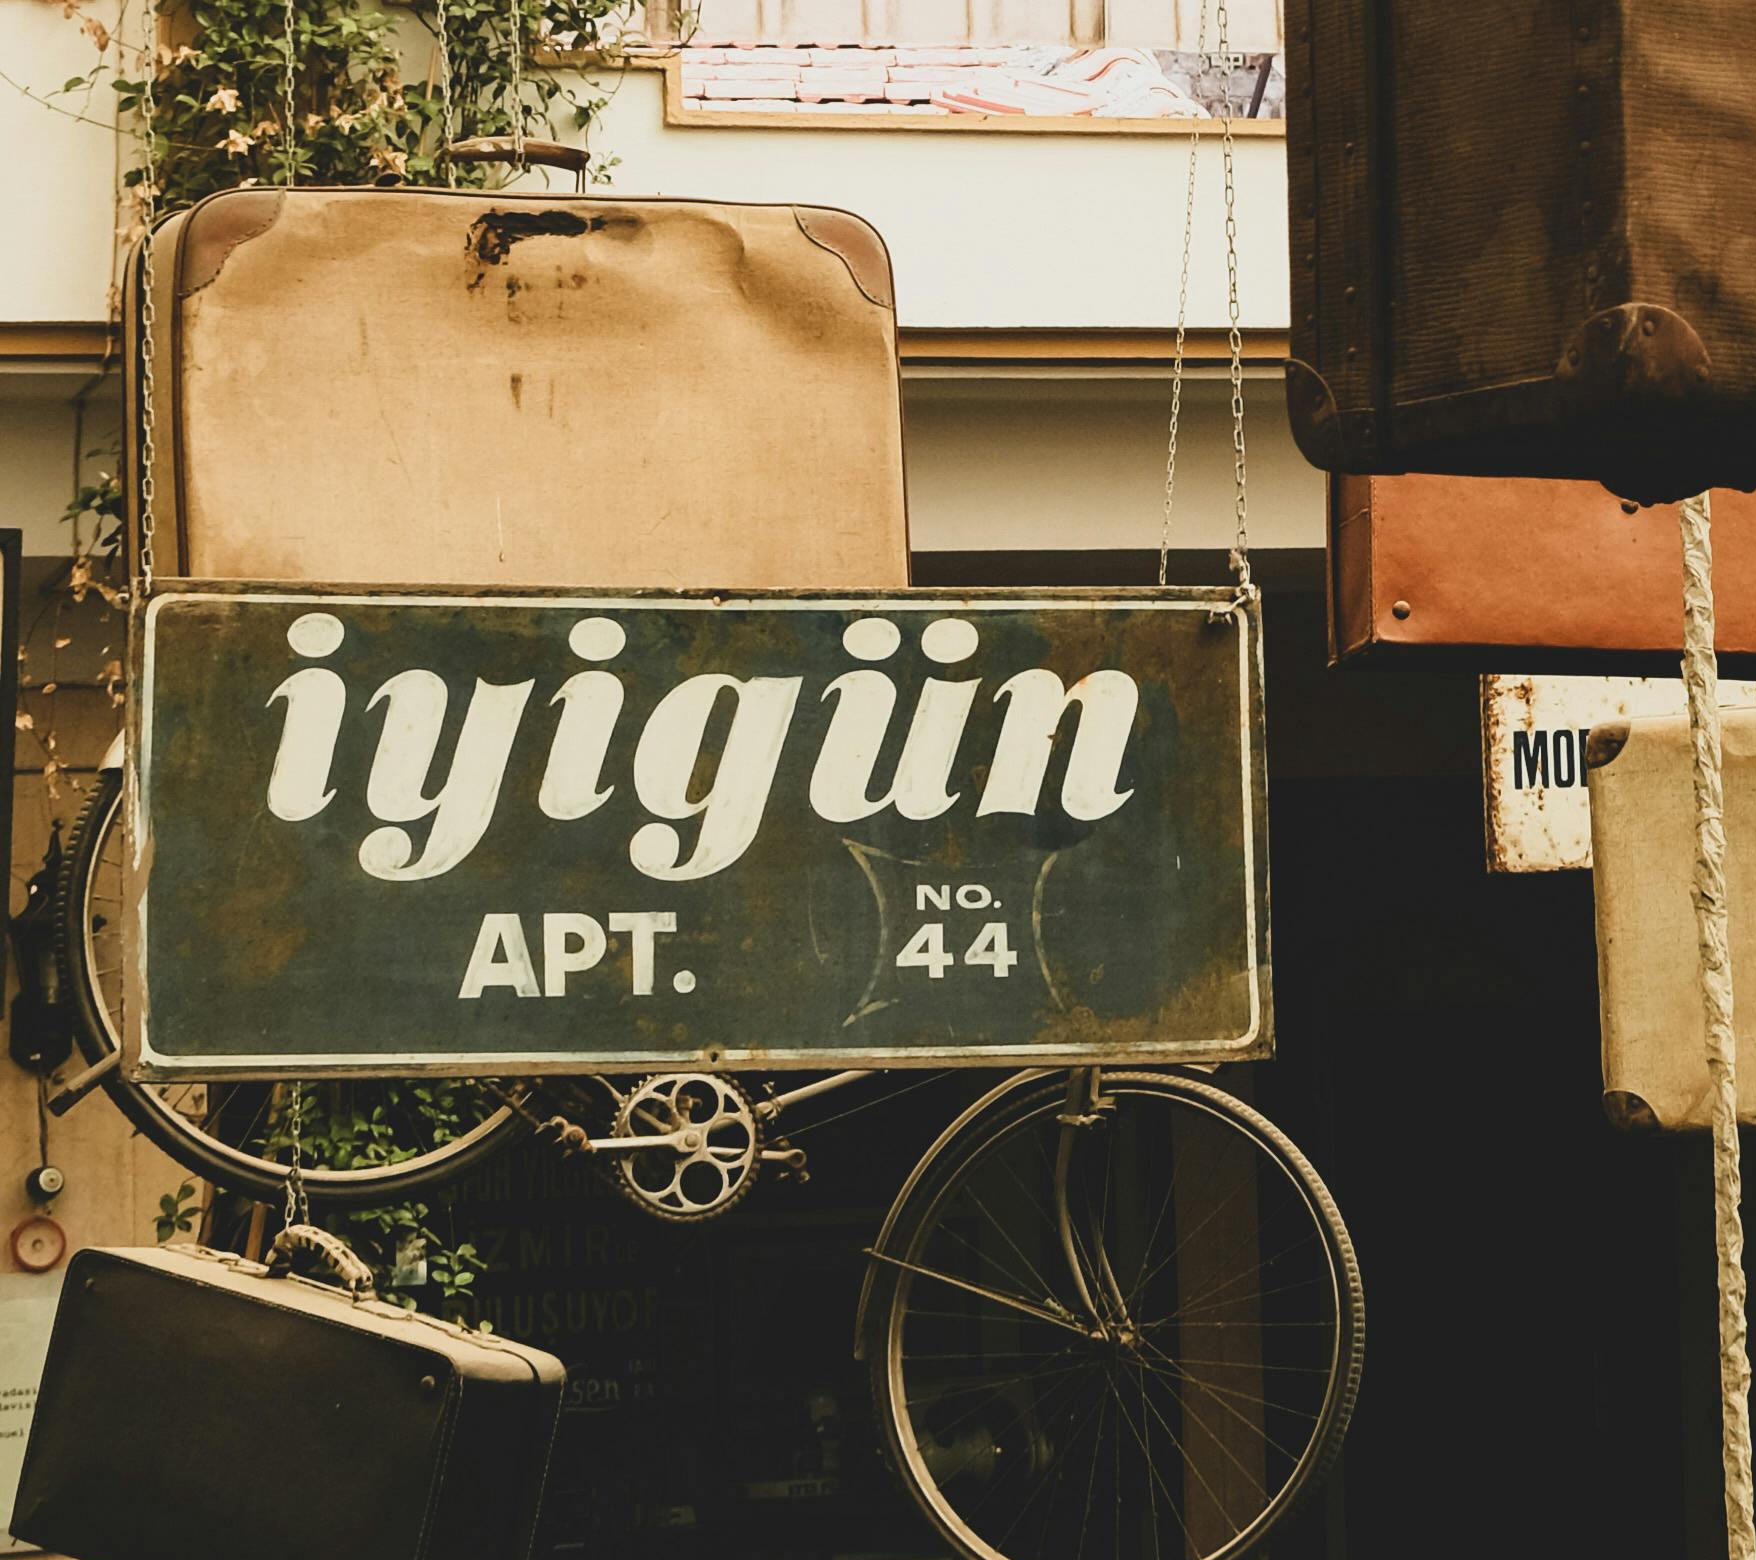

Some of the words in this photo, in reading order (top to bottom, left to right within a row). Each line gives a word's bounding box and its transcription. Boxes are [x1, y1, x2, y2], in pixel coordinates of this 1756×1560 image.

[266, 613, 1139, 881] iyigün
[915, 883, 1002, 910] NO.
[458, 912, 697, 999] APT.
[895, 921, 1018, 979] 44
